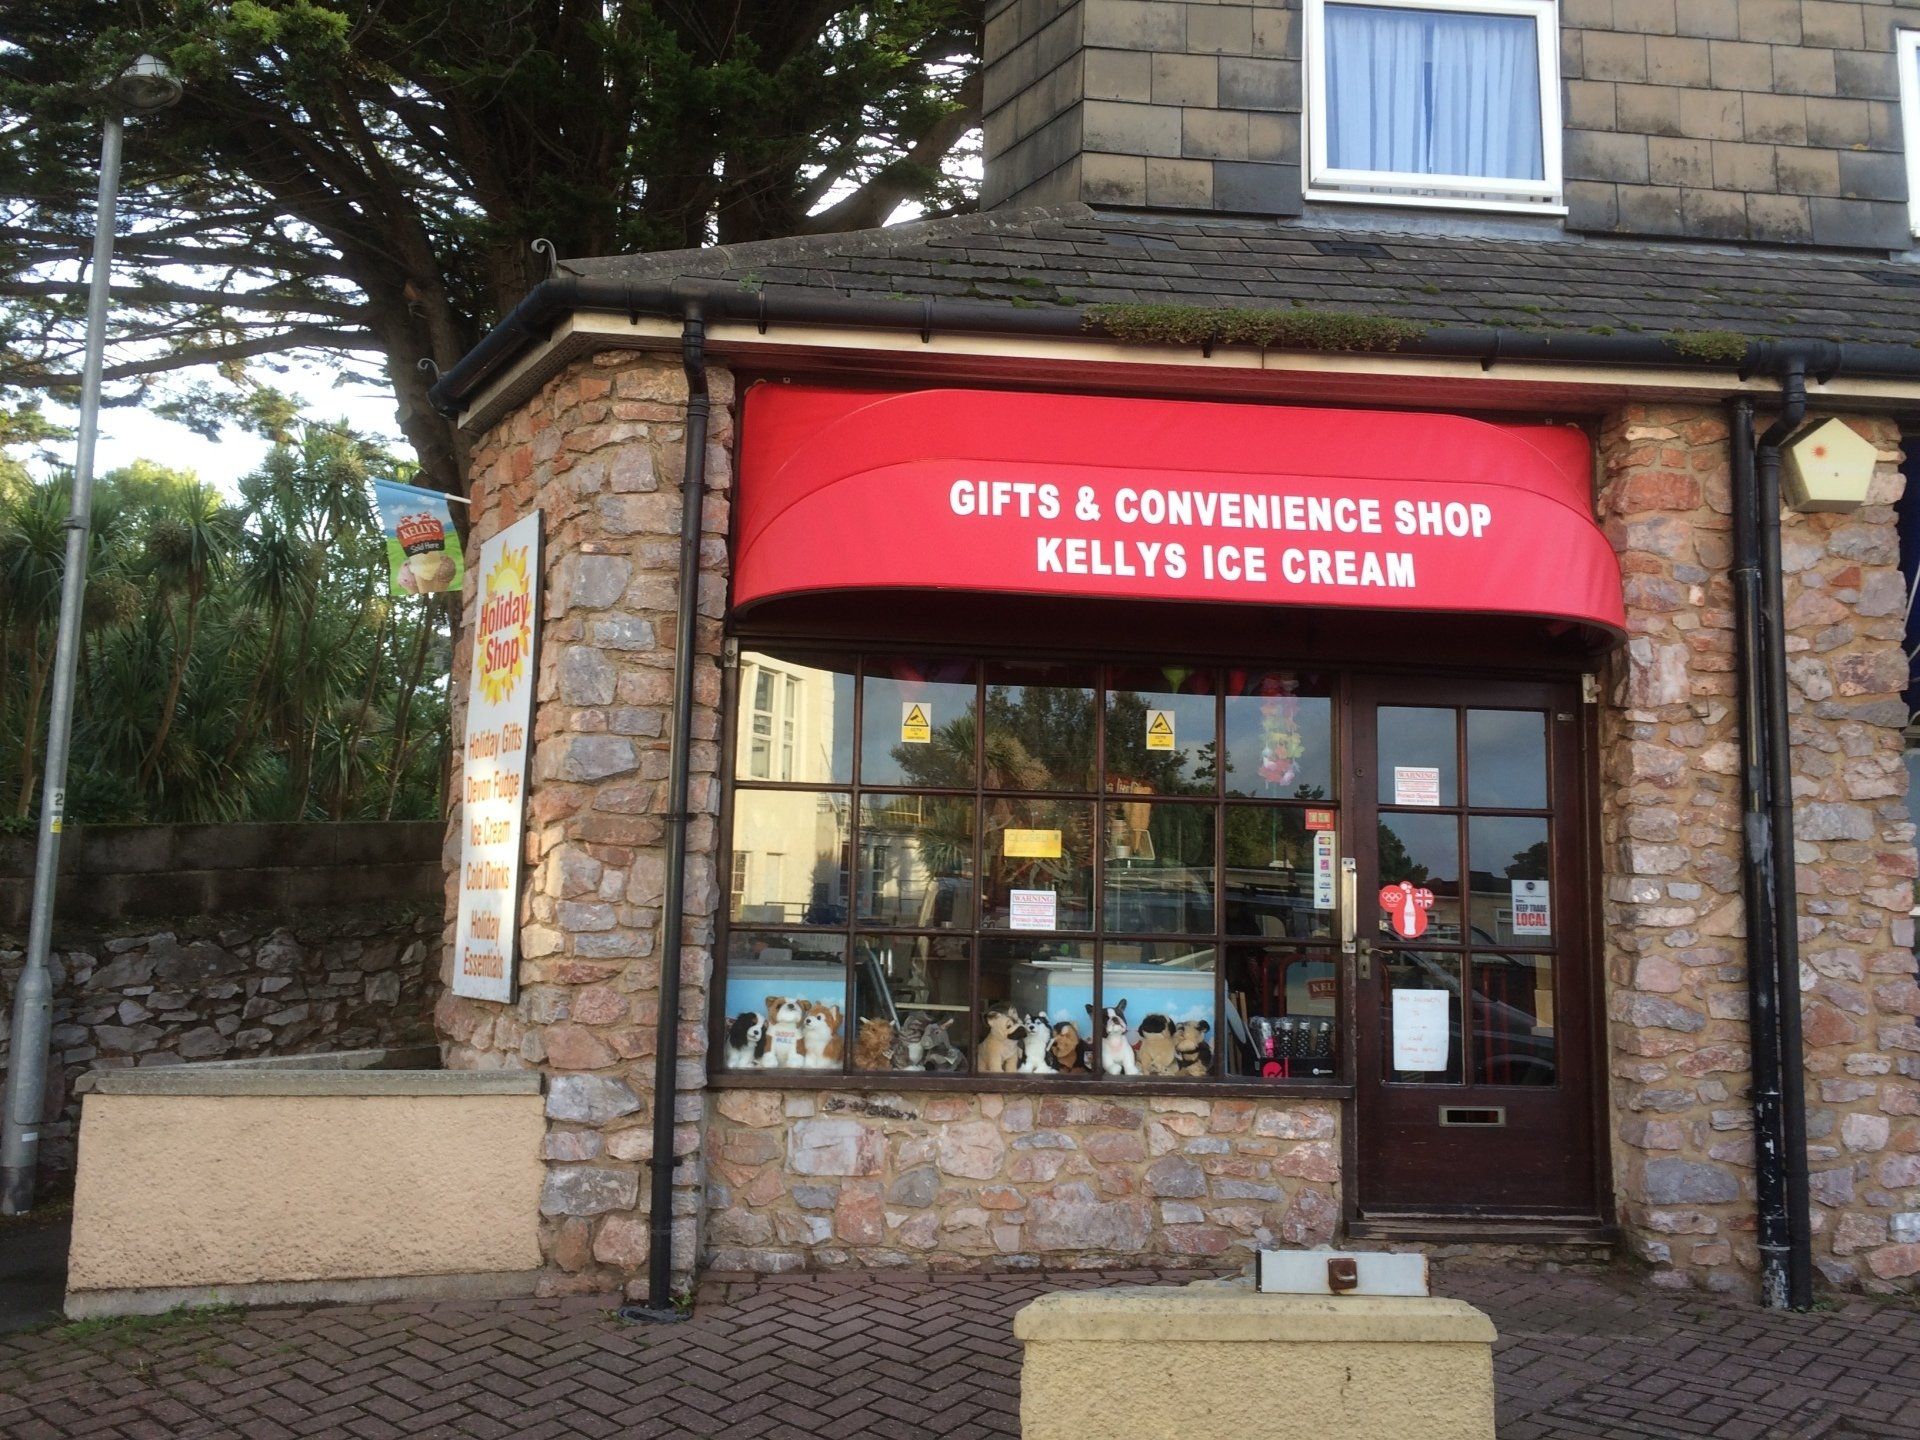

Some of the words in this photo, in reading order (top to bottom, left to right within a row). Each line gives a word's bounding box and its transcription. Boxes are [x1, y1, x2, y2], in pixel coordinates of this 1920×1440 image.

[950, 479, 1061, 519] GIFTS
[1075, 485, 1102, 522] &
[1115, 487, 1383, 534] CONVENIENCE
[1394, 499, 1492, 538] SHOP
[1037, 536, 1188, 579] KELLYS
[1202, 544, 1267, 582] ICE
[1282, 547, 1416, 588] CREAM
[479, 590, 529, 637] Holiday
[484, 636, 519, 675] Shop
[468, 728, 500, 761] Holiday
[502, 722, 523, 754] Gifts
[467, 776, 491, 804] Devon
[494, 767, 520, 804] Fudge
[470, 817, 482, 847] Ice
[484, 816, 510, 846] Cream
[466, 861, 483, 891] Cold
[485, 860, 510, 890] Drinks
[1014, 894, 1053, 903] WARNING
[1529, 904, 1548, 913] TRADE
[470, 910, 501, 946] Holiday
[1516, 912, 1548, 927] LOCAL
[464, 945, 504, 980] Essentials
